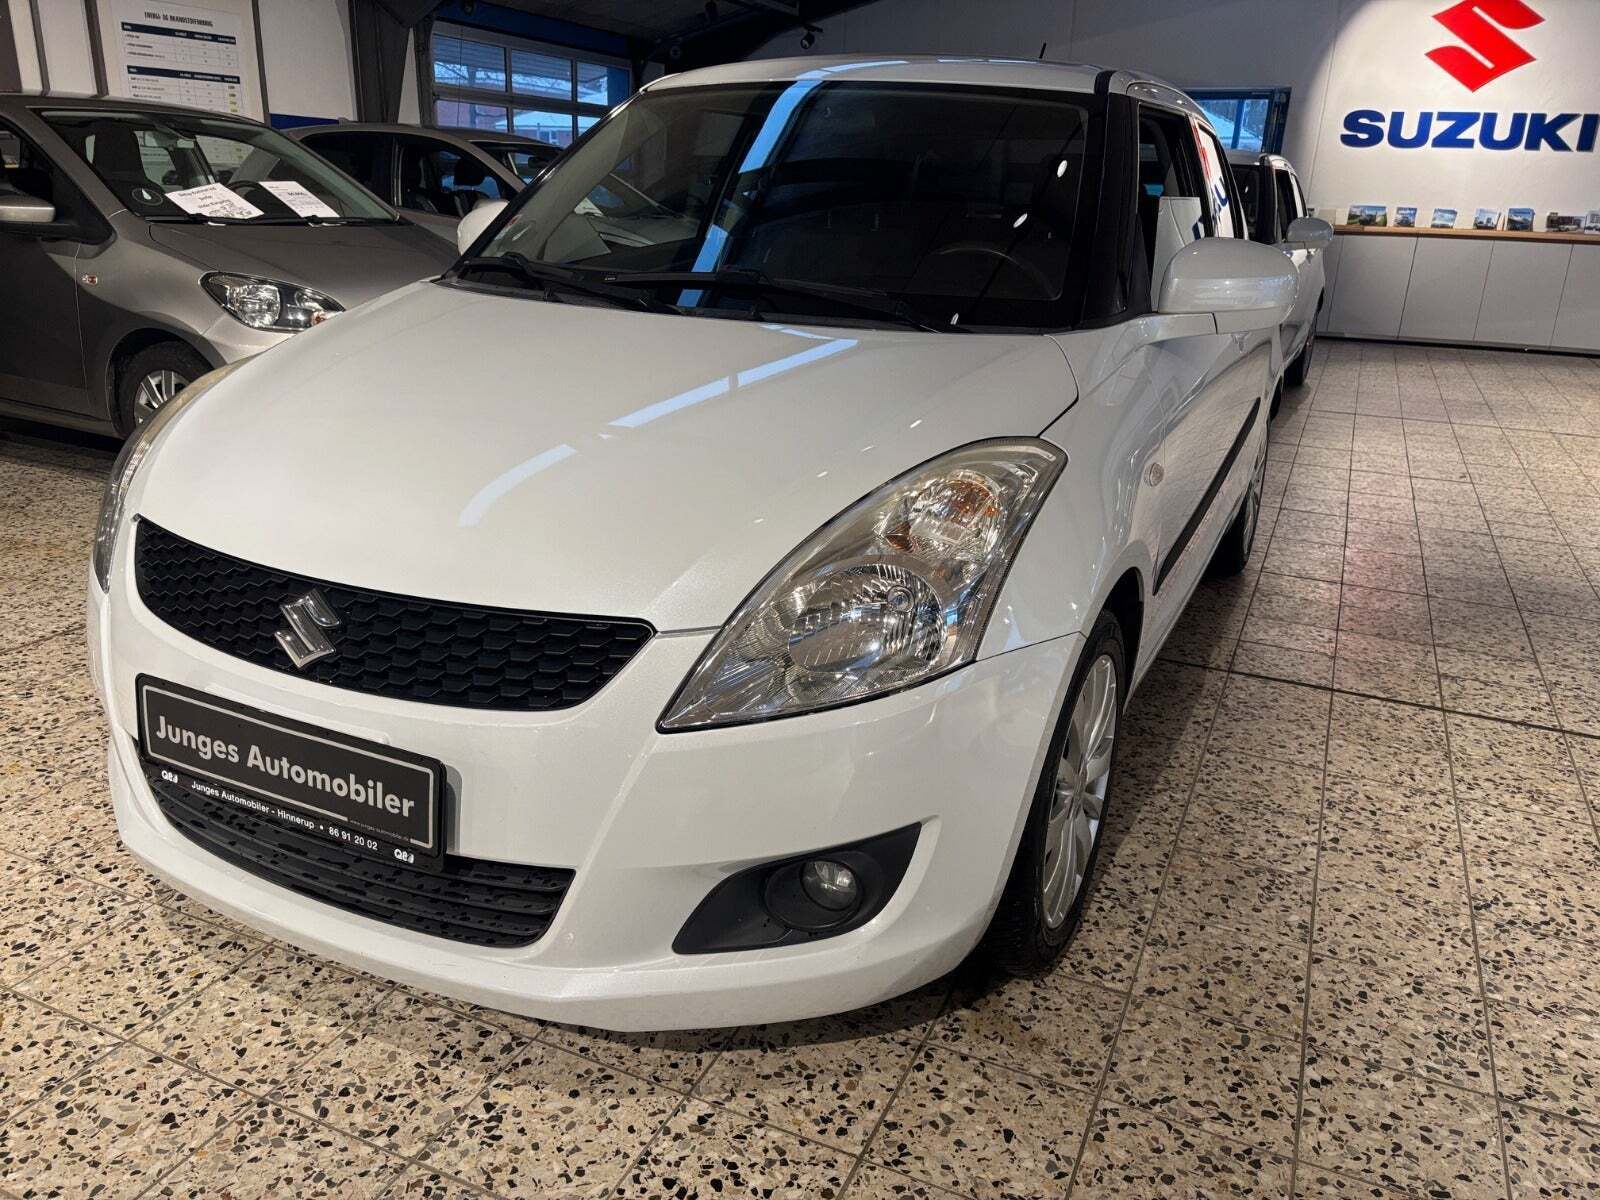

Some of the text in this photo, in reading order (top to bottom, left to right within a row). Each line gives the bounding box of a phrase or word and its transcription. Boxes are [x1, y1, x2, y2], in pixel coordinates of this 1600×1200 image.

[1340, 109, 1600, 152] SUZUKI
[156, 716, 415, 817] Junges Automobiler
[191, 780, 219, 797] Junges
[221, 790, 270, 814] Automobiler
[277, 808, 315, 830] Hinnerup
[328, 826, 340, 838] 86
[341, 831, 351, 841] 91
[354, 835, 365, 846] 20
[366, 840, 378, 851] 02
